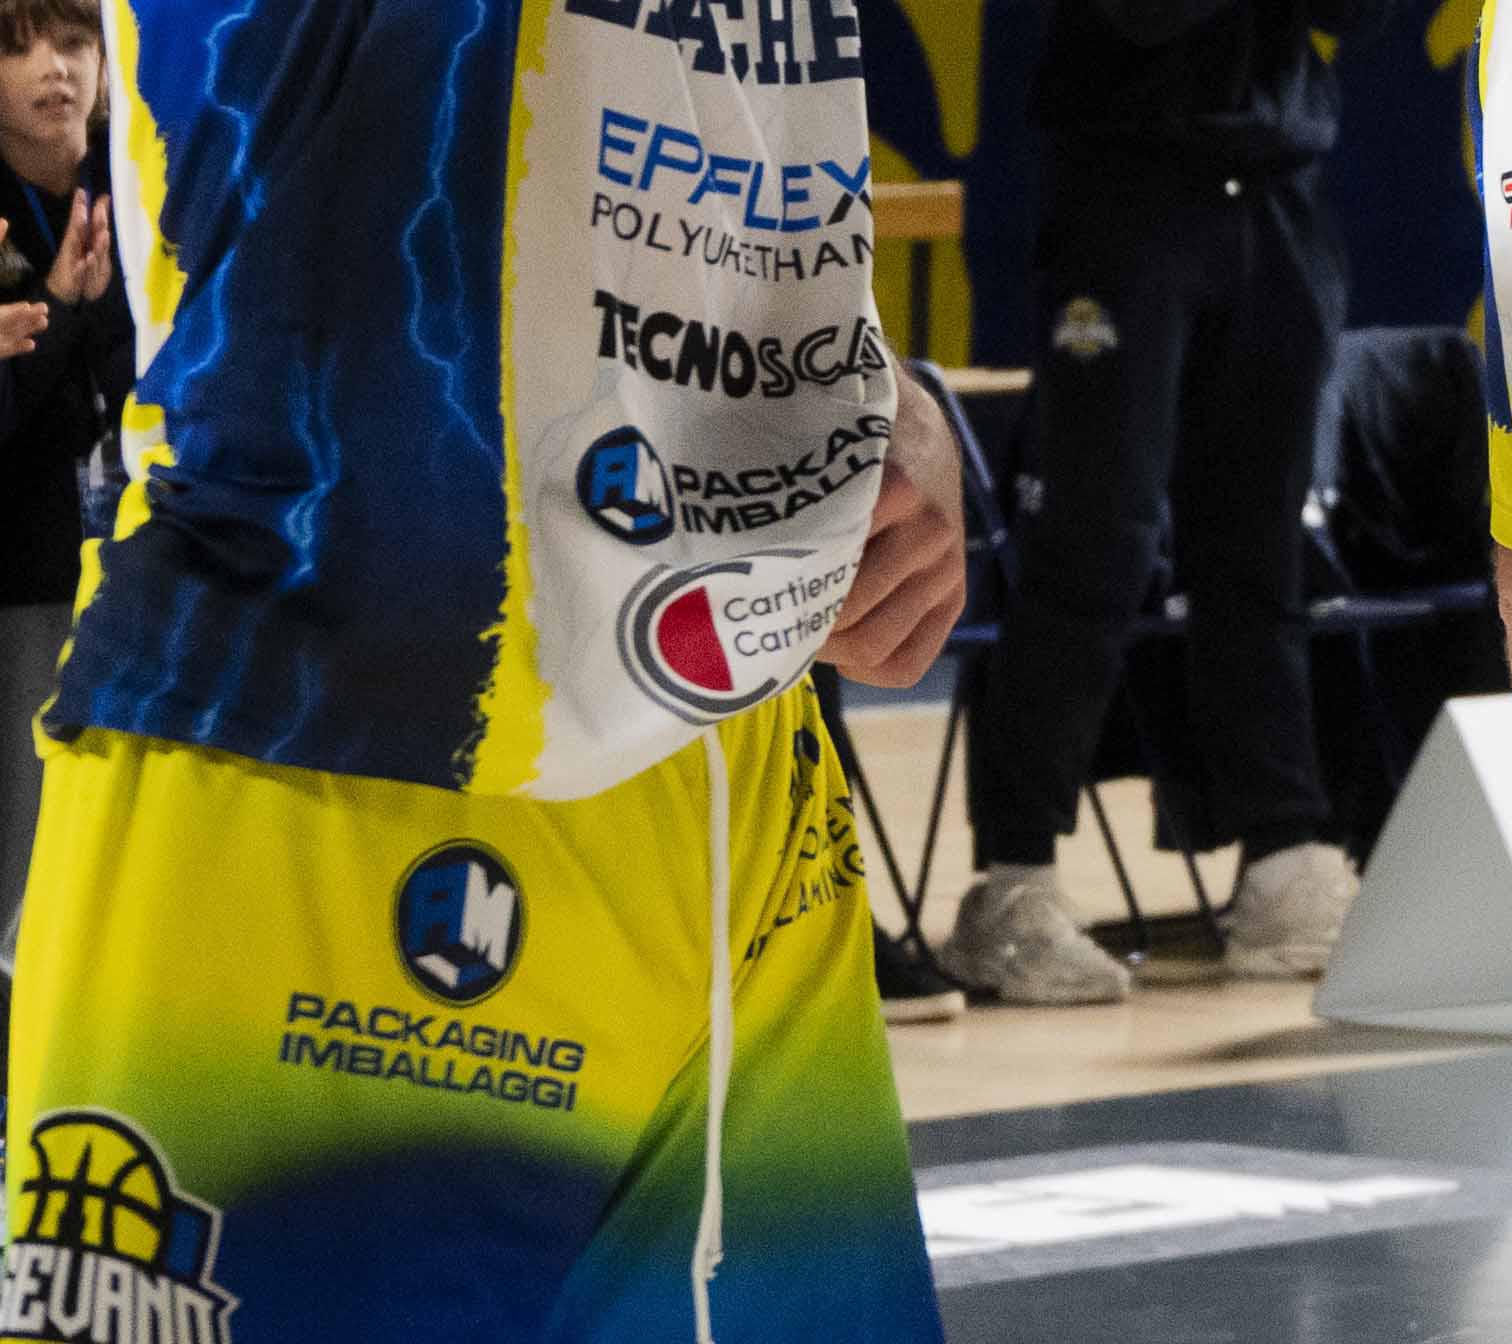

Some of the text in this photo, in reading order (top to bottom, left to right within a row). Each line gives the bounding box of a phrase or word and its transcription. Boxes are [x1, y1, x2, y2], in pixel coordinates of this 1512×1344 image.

[594, 290, 887, 398] TECNOSCA
[672, 415, 892, 499] PACKAG
[681, 452, 881, 535] IMBALL
[723, 564, 847, 622] Cartiera
[279, 1031, 578, 1112] IMBALLAGGI
[287, 992, 586, 1073] PACKAGING
